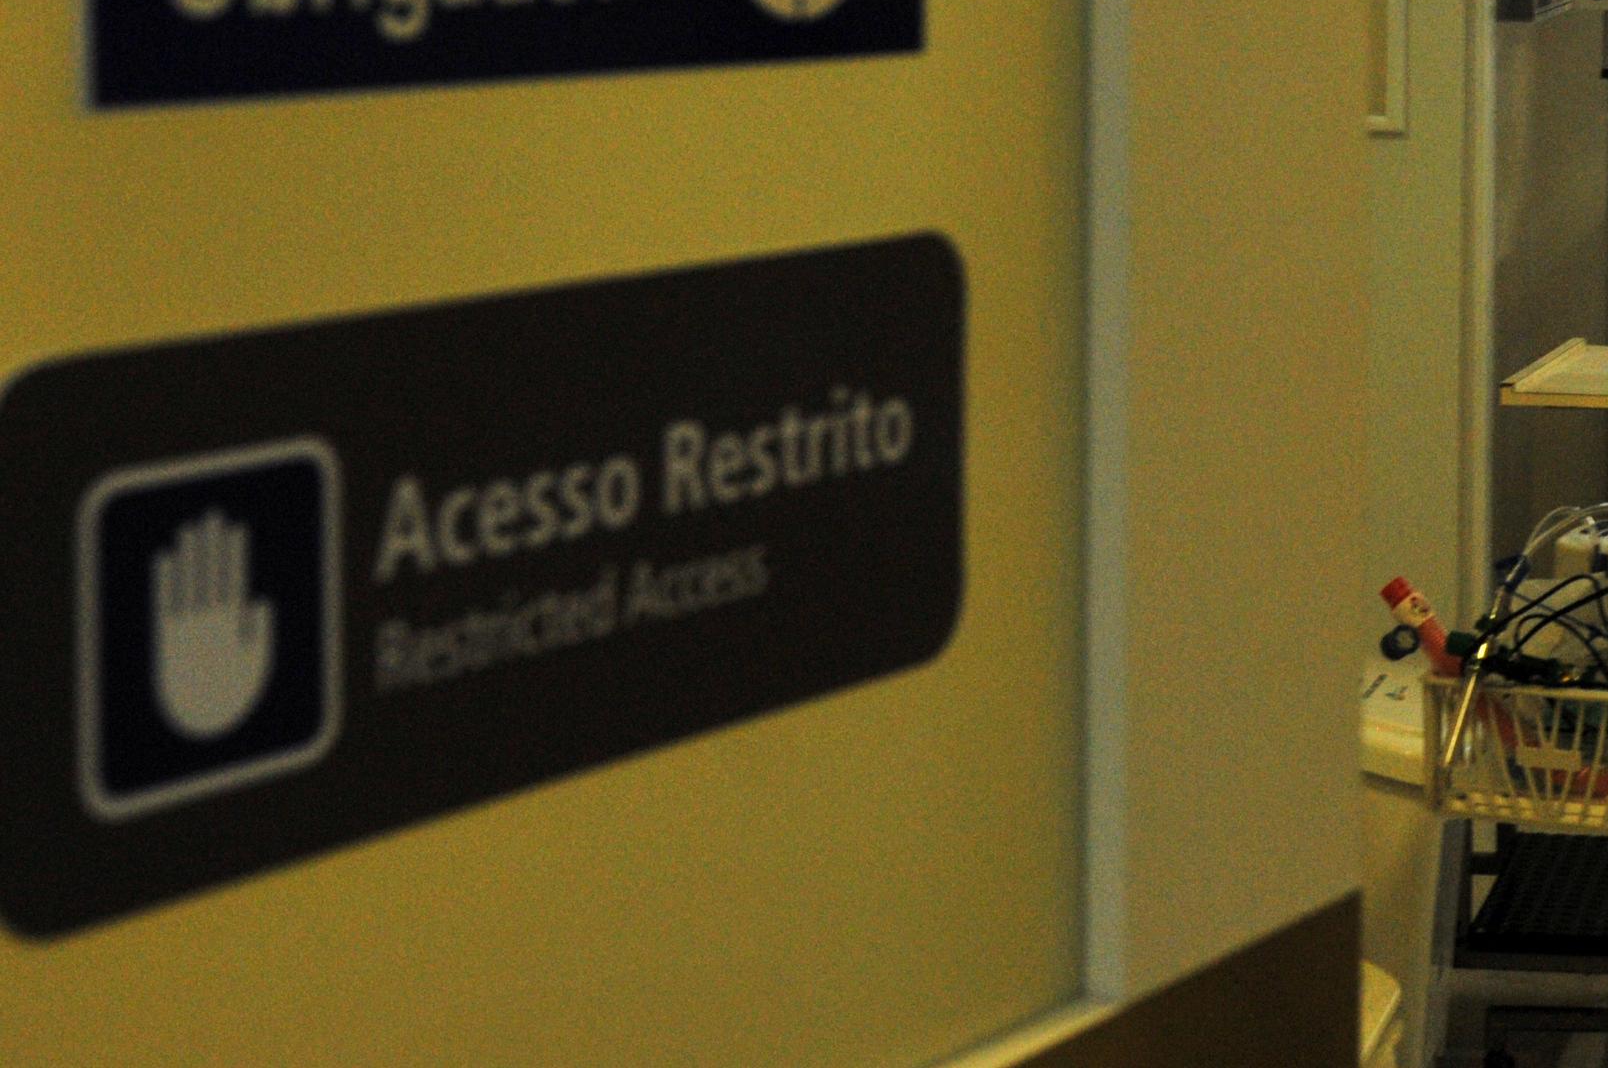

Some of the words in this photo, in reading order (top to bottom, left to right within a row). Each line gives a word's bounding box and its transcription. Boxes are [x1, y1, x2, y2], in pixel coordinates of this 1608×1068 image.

[373, 450, 642, 586] Acesso
[660, 385, 916, 516] Restrito
[374, 568, 618, 690] Restricted
[625, 544, 769, 620] Access
